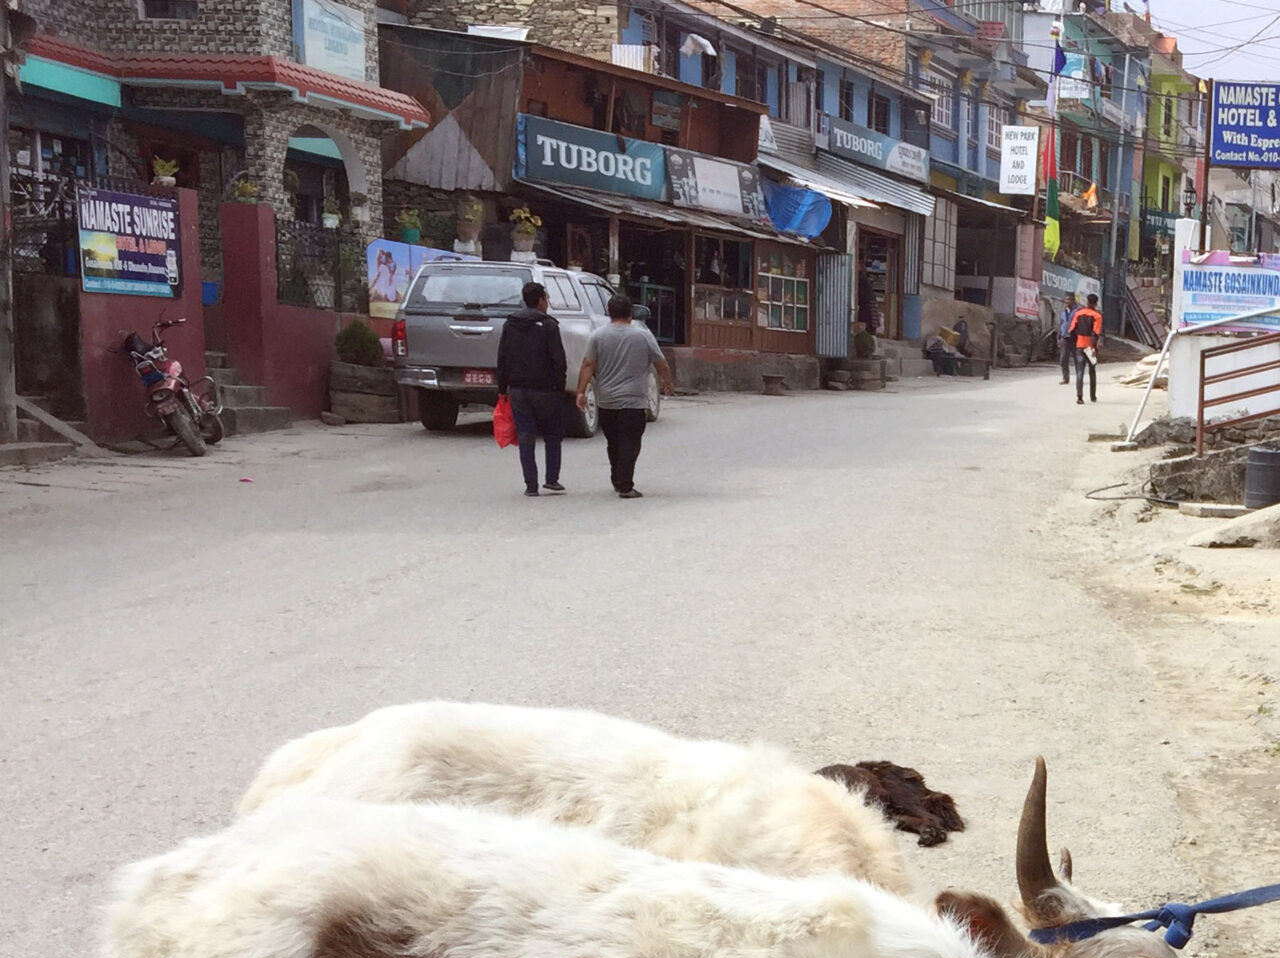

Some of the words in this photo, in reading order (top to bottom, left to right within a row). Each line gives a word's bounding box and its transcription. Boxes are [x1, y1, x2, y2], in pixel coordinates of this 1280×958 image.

[1219, 86, 1276, 107] NAMASTE
[1218, 108, 1263, 127] HOTEL
[1267, 110, 1277, 127] &
[834, 127, 883, 161] TUBORG
[1005, 131, 1019, 140] NEW
[1020, 131, 1035, 141] PARK
[1222, 130, 1248, 146] With
[1010, 145, 1028, 155] HOTEL
[1215, 149, 1246, 162] Contact
[536, 134, 653, 186] TUBORG
[1012, 160, 1025, 169] AND
[1008, 174, 1027, 184] LODGE
[81, 199, 132, 234] NAMASTE
[133, 205, 175, 240] SUNRISE
[1182, 270, 1223, 293] NAMASTE
